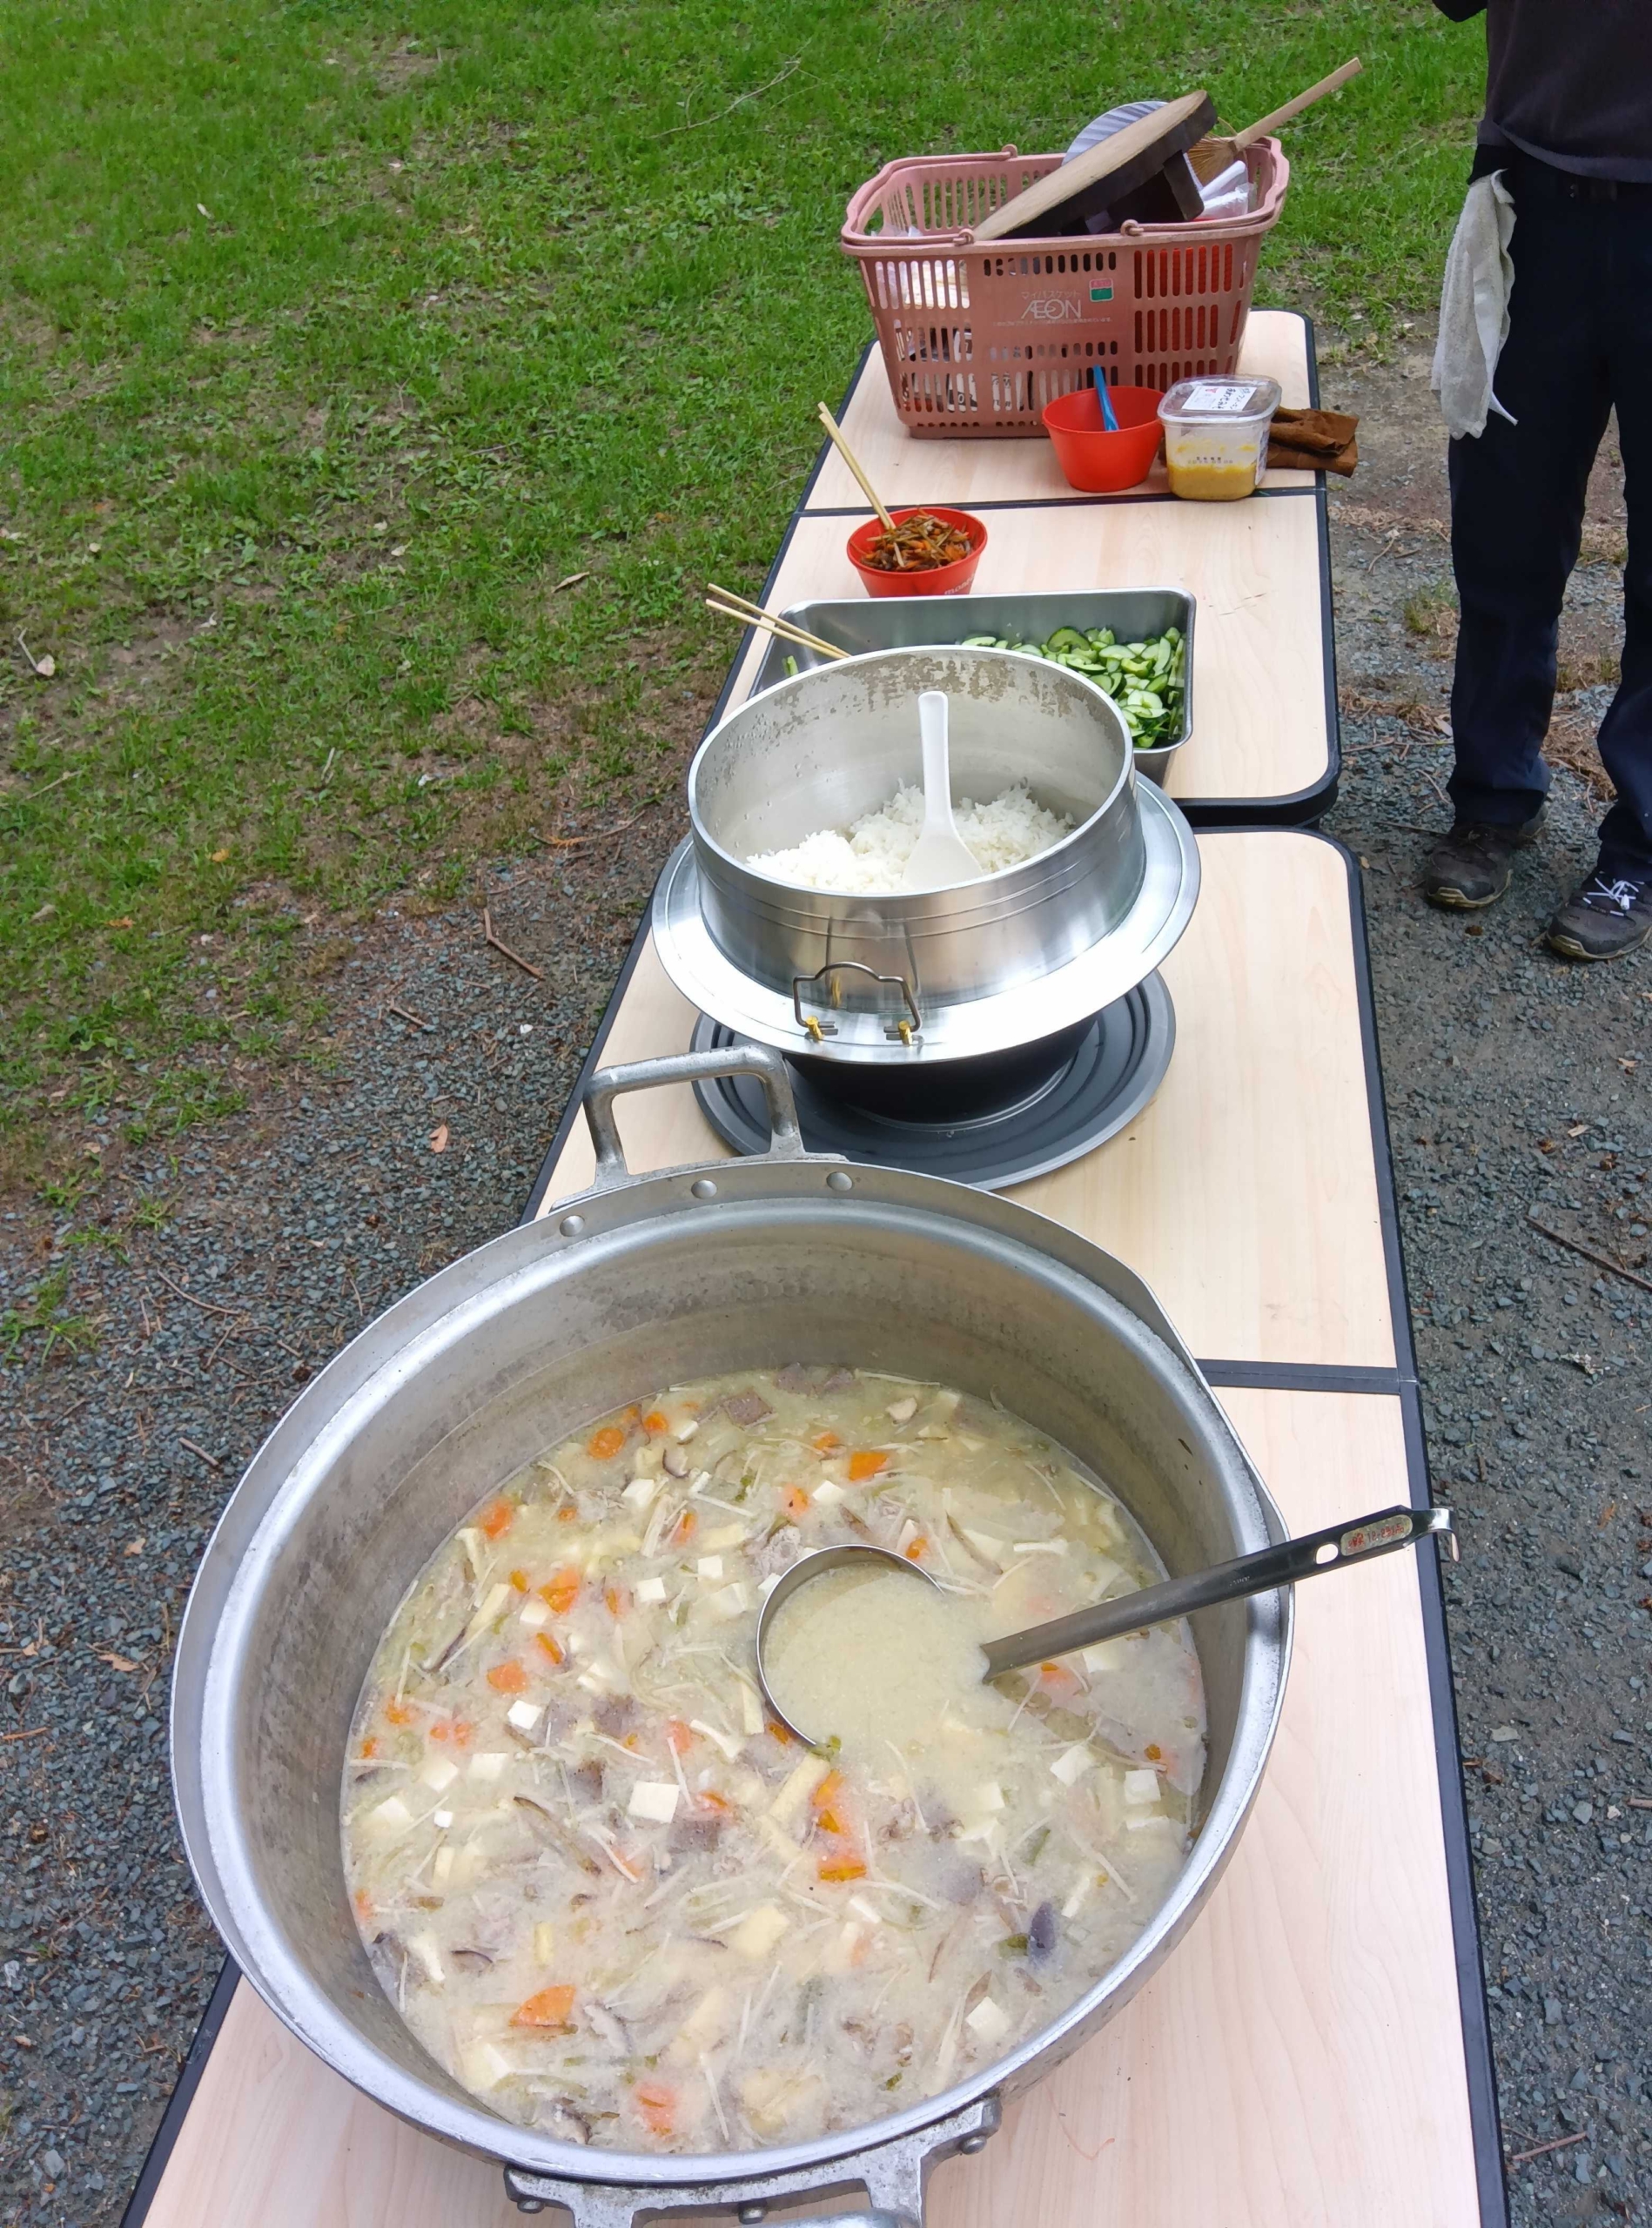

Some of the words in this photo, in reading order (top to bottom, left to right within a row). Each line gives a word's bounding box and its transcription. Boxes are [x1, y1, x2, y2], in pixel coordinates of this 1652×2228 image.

[1021, 289, 1081, 300] マイバスケット
